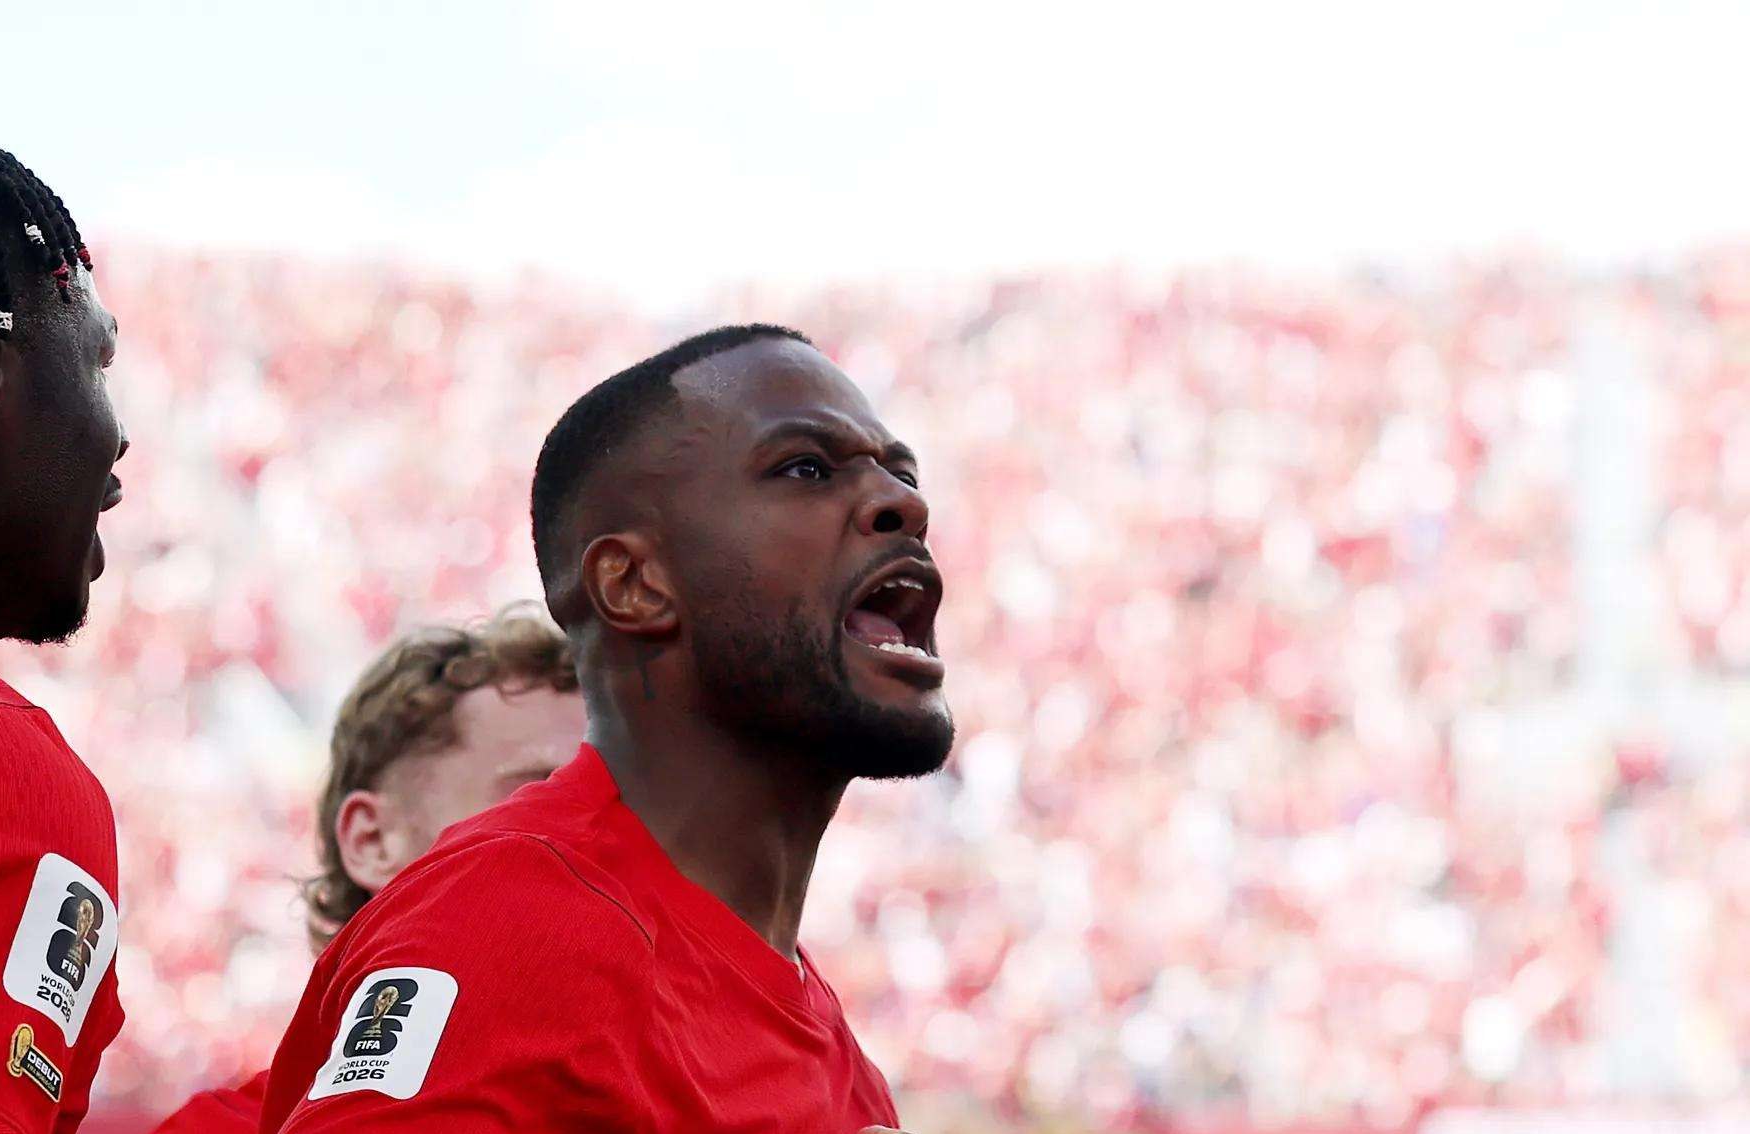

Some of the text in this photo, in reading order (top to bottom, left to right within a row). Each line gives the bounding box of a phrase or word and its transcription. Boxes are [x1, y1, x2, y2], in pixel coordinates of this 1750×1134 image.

[61, 958, 80, 982] FIFA
[354, 1039, 381, 1051] FIFA
[27, 1050, 61, 1086] DEBUT
[331, 1068, 386, 1085] 2026
